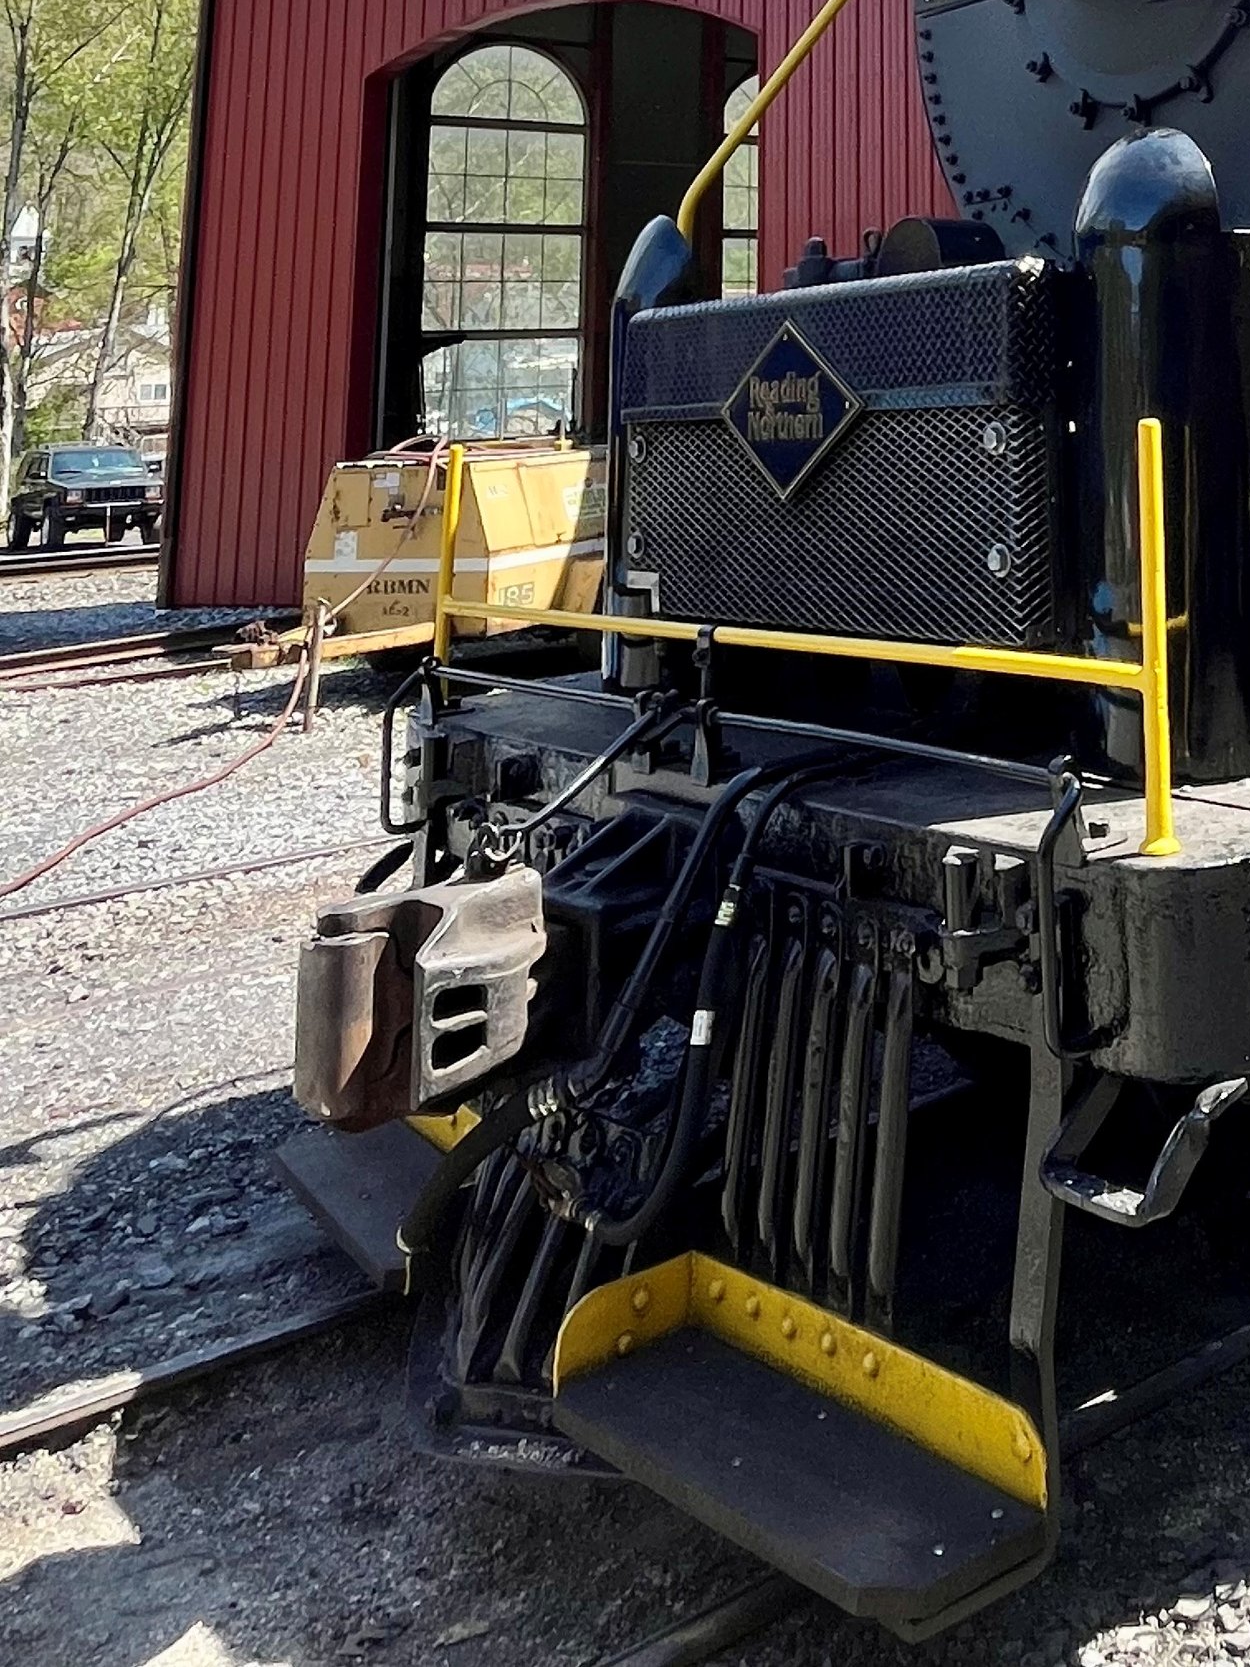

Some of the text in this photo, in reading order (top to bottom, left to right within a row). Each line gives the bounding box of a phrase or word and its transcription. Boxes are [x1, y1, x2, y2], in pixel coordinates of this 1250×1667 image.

[749, 370, 821, 413] Reading
[747, 411, 823, 441] Northern
[366, 579, 430, 595] RBMN
